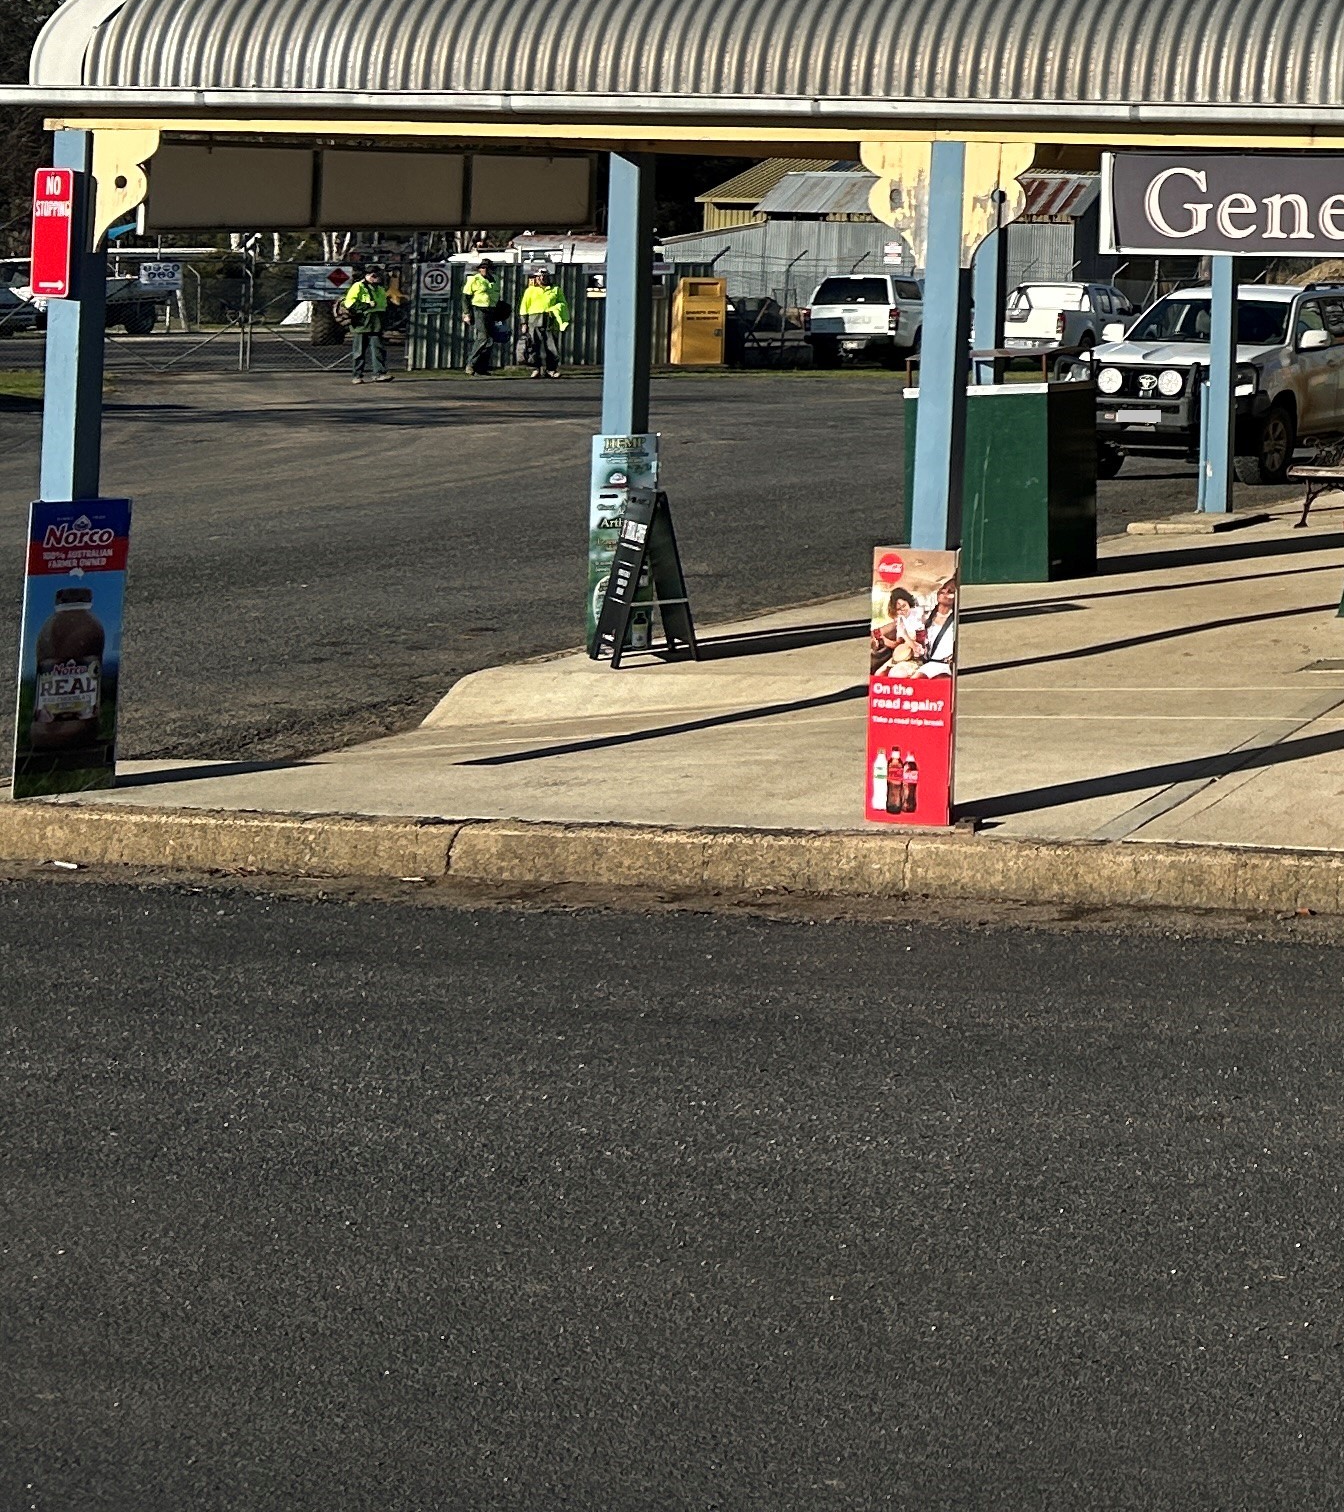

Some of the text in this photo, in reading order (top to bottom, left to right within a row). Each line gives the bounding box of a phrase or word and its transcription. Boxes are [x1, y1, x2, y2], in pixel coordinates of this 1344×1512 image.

[45, 175, 62, 196] NO
[428, 273, 444, 285] 10
[604, 437, 646, 449] HEMP
[43, 522, 115, 548] Norco
[66, 548, 114, 559] AUSTRALIAN
[47, 557, 107, 569] FARMER OWNED
[40, 676, 96, 696] REAL
[872, 682, 914, 697] On the
[872, 698, 945, 713] road again?
